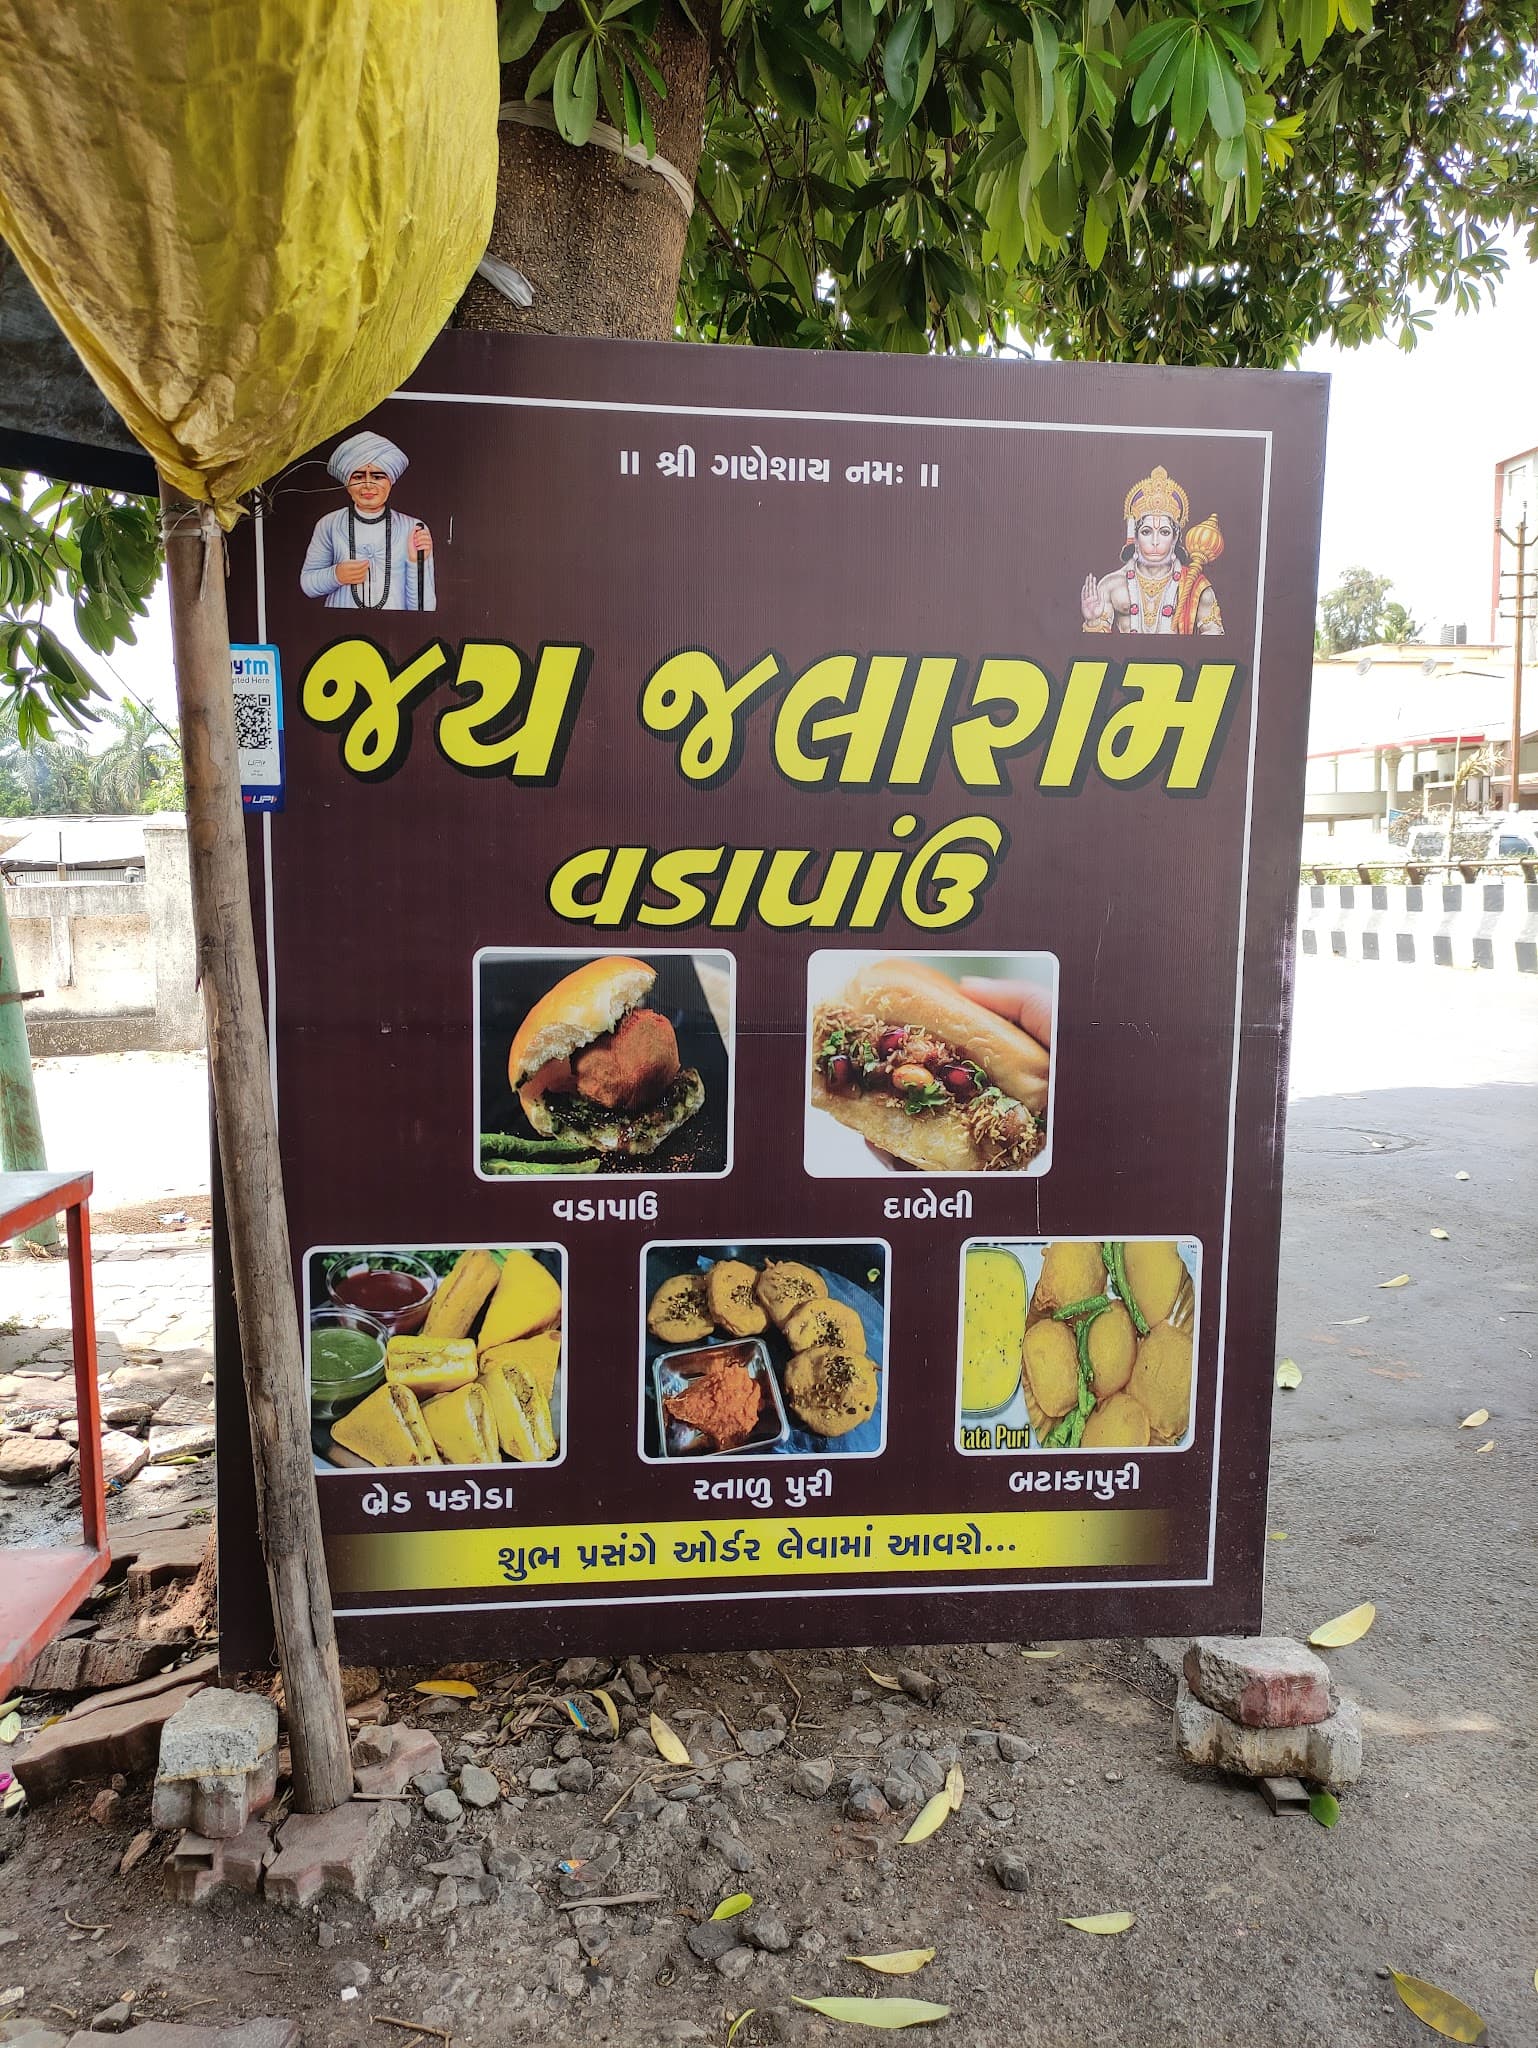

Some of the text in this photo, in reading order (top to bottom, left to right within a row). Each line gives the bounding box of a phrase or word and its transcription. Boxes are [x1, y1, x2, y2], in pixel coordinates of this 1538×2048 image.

[655, 444, 696, 477] શ્રી
[710, 445, 831, 482] ગણેશાય
[230, 657, 269, 675] ytm
[300, 637, 1243, 795] જય જલારામ
[547, 813, 1008, 933] વડાપાંઉ
[552, 1190, 659, 1222] વડાપાઉ
[883, 1188, 973, 1220] દાબેલી
[996, 1424, 1030, 1449] Puri
[361, 1479, 513, 1516] બ્રેડ પકોડા
[693, 1468, 833, 1509] રતાળુ પુરી
[1008, 1461, 1140, 1500] બટાકાપુરી
[498, 1546, 560, 1582] શુભ
[577, 1532, 656, 1570] પ્રસંગે
[673, 1529, 761, 1563] ઓર્ડર
[777, 1524, 873, 1559] લેવામાં
